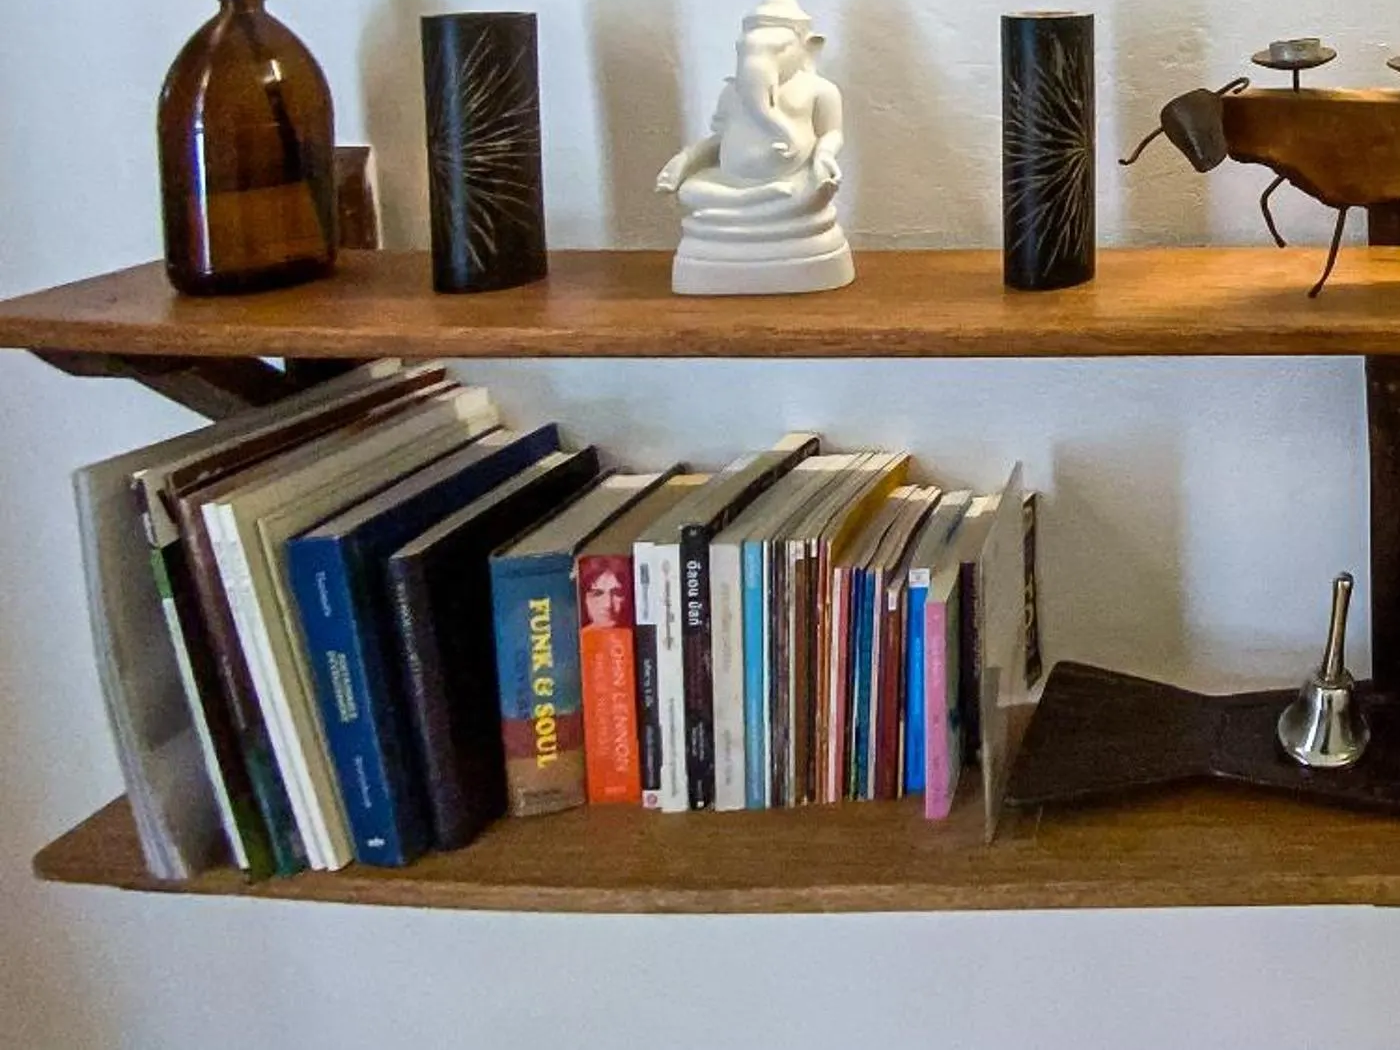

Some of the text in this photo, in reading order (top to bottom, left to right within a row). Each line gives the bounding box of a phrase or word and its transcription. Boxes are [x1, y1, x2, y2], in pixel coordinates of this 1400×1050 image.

[528, 597, 558, 769] FUNK & SOUL
[610, 633, 630, 772] JOHN LENNON
